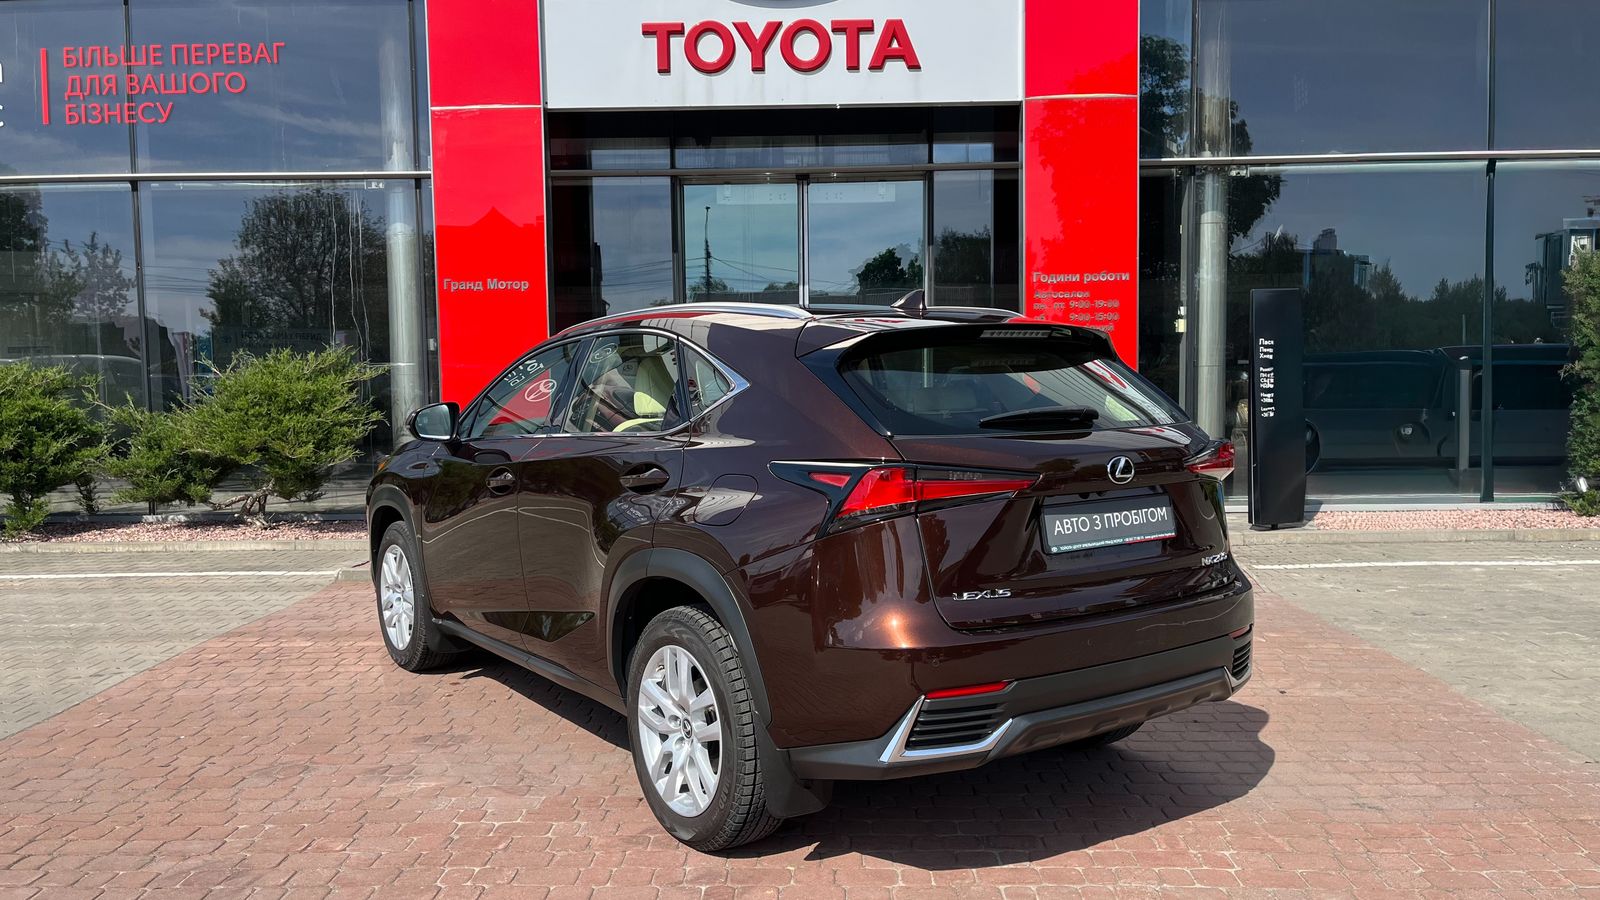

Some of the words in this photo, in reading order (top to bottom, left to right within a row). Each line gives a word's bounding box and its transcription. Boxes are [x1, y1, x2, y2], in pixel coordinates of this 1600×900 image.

[63, 44, 163, 68] БІЛЬШЕ
[171, 42, 285, 65] ПЕРЕВАГ
[641, 18, 921, 74] TOYOTA
[64, 74, 117, 100] ДЛЯ
[127, 72, 247, 95] ВАШОГО
[65, 102, 173, 125] БІЗНЕСУ
[443, 278, 483, 292] Гранд
[487, 278, 529, 292] Мотор
[1032, 272, 1080, 284] Години
[1083, 271, 1130, 284] роботи
[1034, 290, 1090, 299] Автосалон
[1054, 516, 1090, 536] АВТО
[1103, 506, 1168, 529] ПРОБІГОМ
[952, 588, 1012, 601] LEXUS
